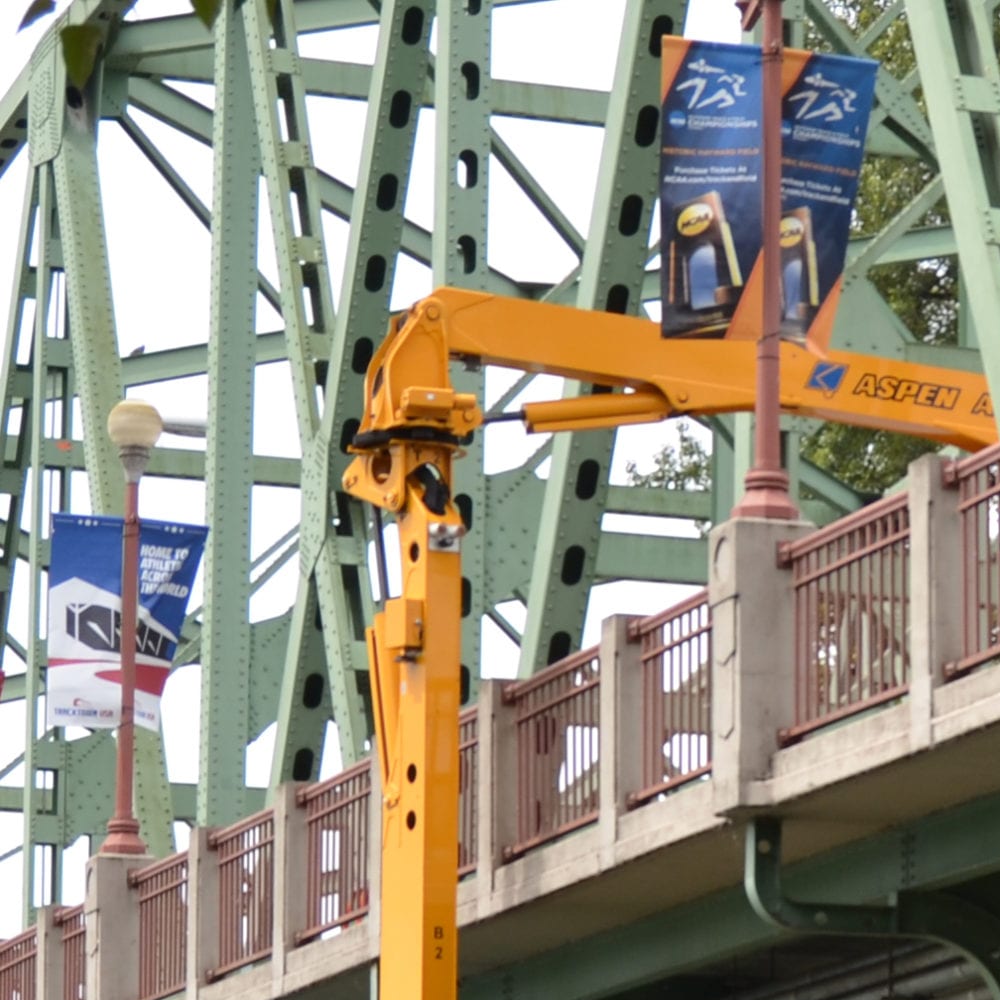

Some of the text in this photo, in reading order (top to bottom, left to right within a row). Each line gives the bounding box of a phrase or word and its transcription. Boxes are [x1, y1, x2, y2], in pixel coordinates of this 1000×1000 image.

[852, 373, 961, 410] ASPEN
[141, 544, 190, 561] HOME TO
[433, 926, 444, 940] B
[434, 945, 443, 960] 2
